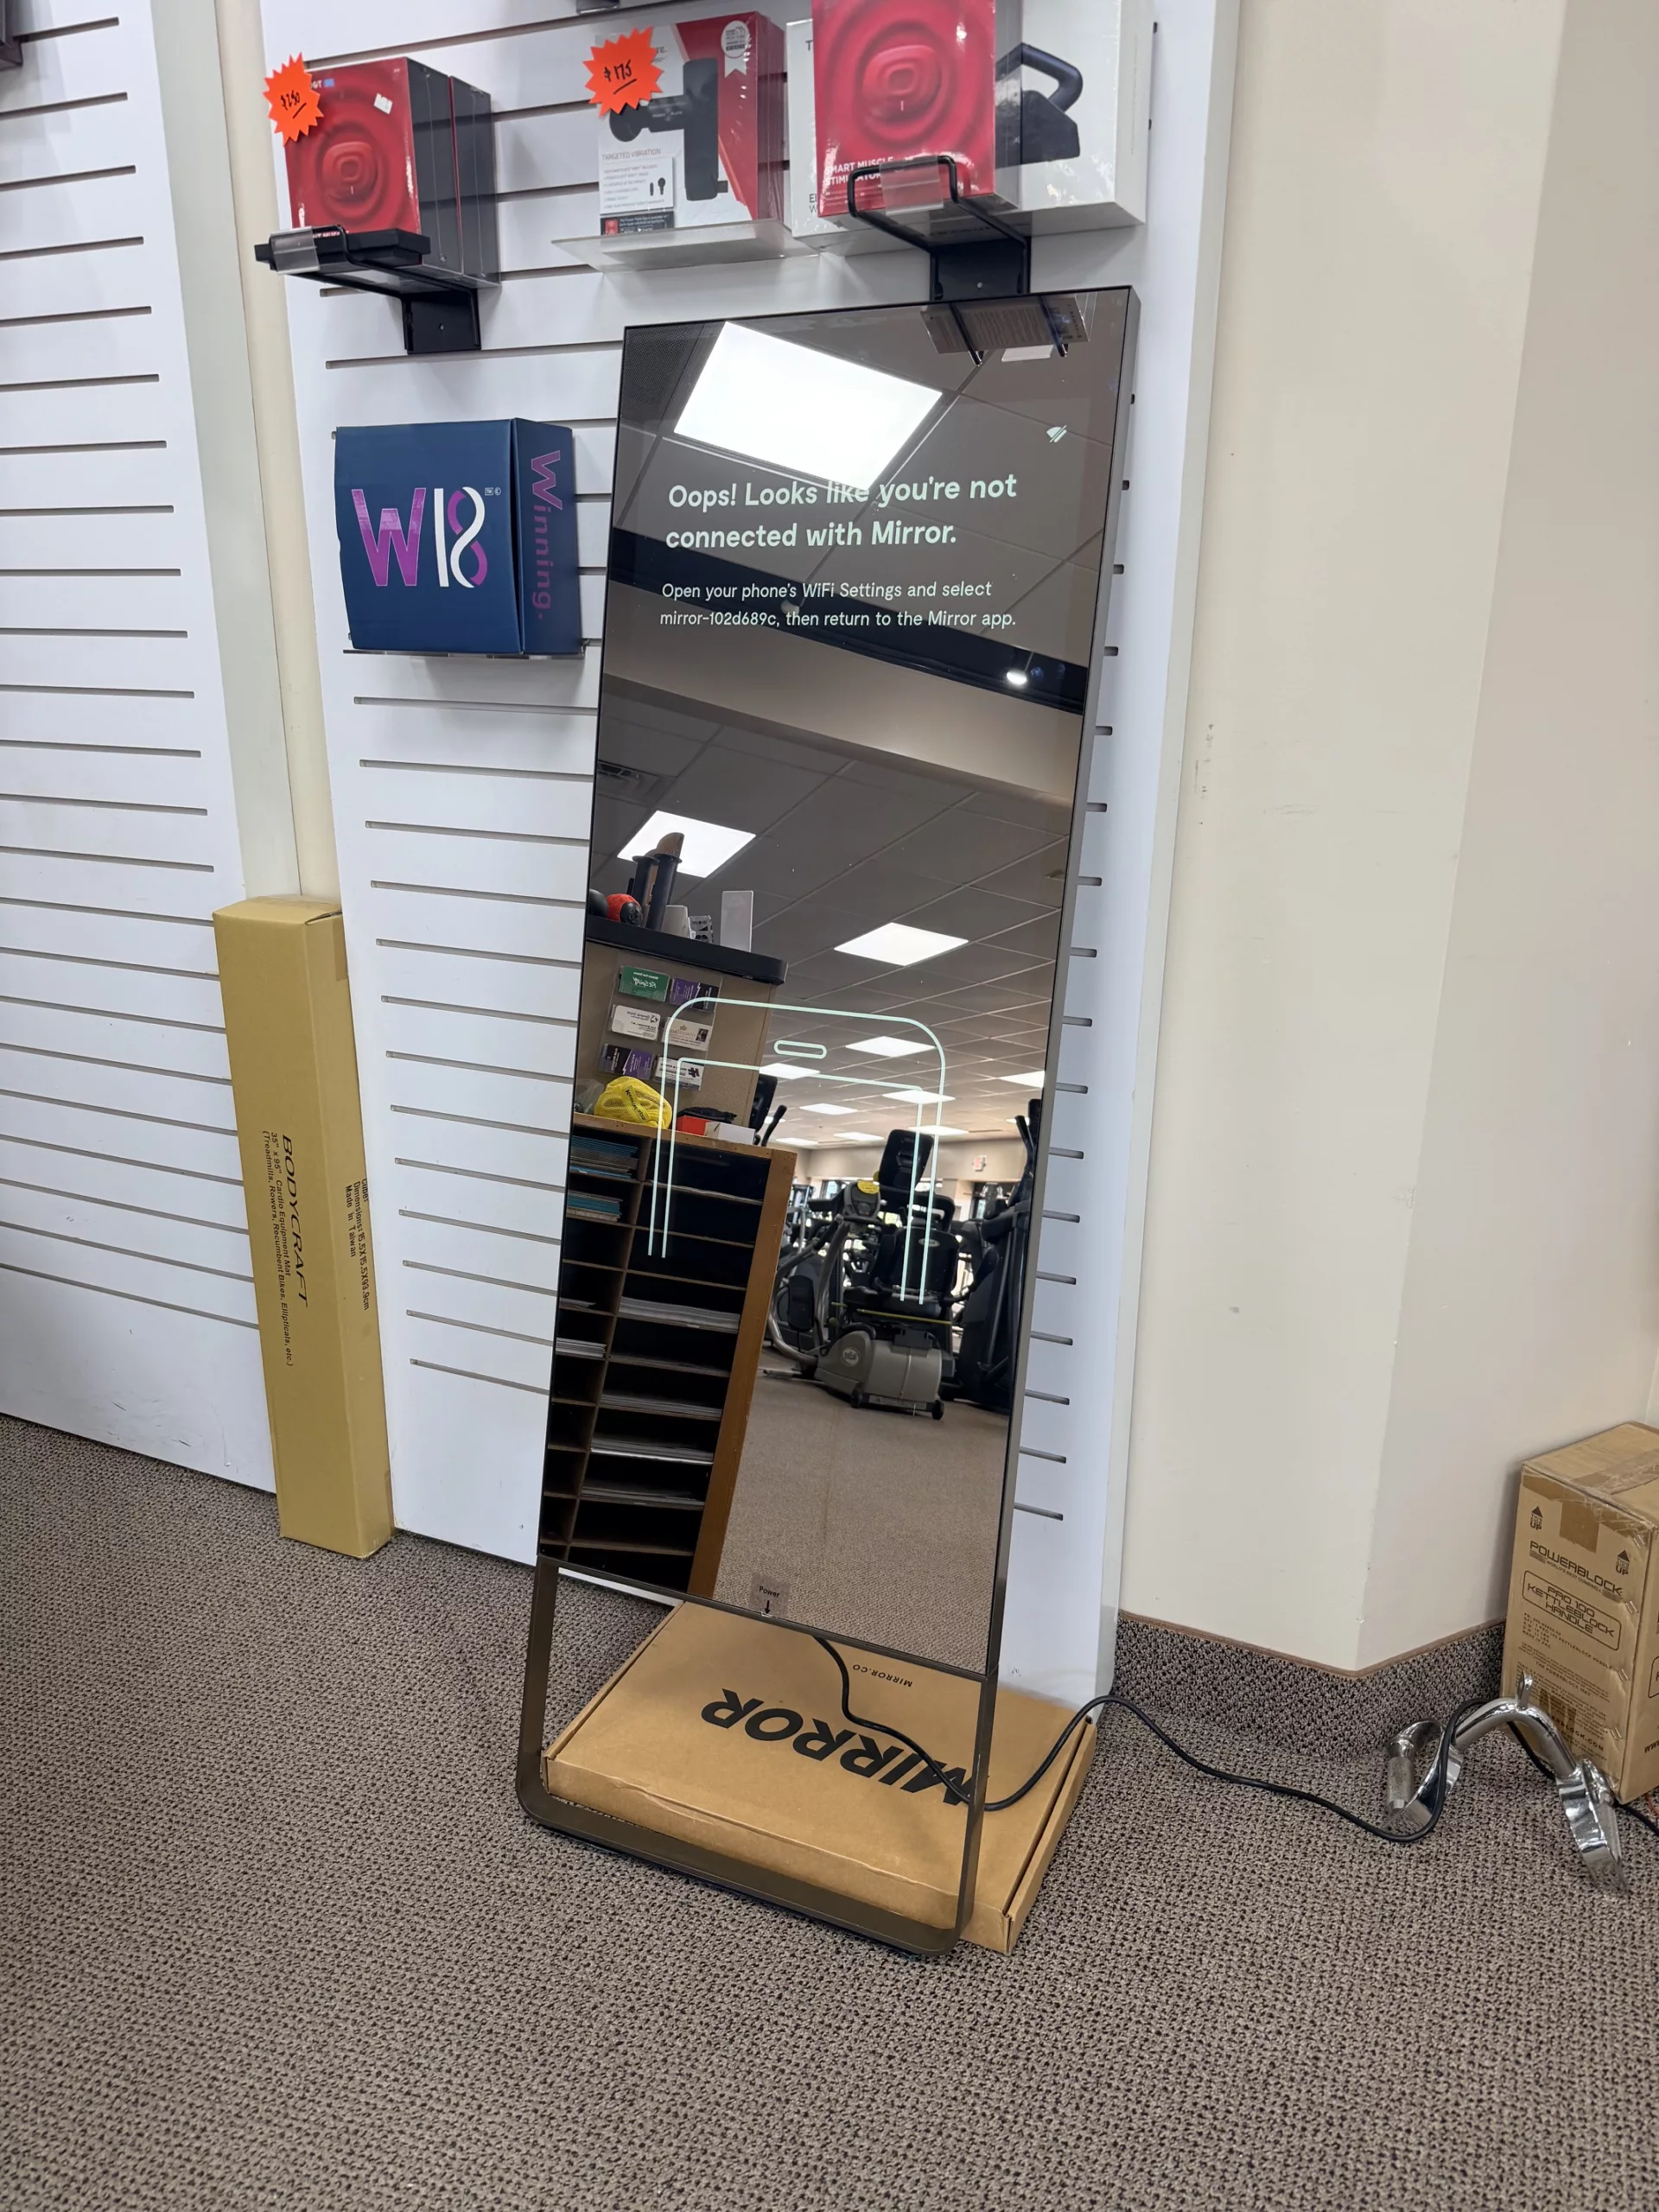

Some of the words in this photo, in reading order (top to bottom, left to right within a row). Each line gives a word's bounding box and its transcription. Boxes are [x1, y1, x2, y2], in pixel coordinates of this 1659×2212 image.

[603, 59, 632, 82] $175
[601, 151, 631, 161] TARGETED
[632, 149, 661, 157] VIBRATION
[668, 483, 737, 512] Oops!
[745, 481, 817, 506] Looks
[826, 480, 870, 504] like
[877, 476, 961, 508] you're
[969, 474, 1017, 499] not
[665, 523, 798, 549] connected
[806, 522, 862, 547] with
[871, 520, 957, 546] Mirror.
[662, 582, 701, 602] Open
[705, 584, 738, 602] your
[741, 582, 797, 601] phone's
[802, 582, 835, 597] WiFi
[839, 582, 902, 601] Settings
[907, 582, 937, 597] and
[942, 581, 993, 596] select
[659, 610, 780, 628] mirror-102d689c,
[785, 610, 819, 626] then
[823, 612, 870, 627] return
[874, 612, 892, 626] to
[897, 610, 923, 626] the
[928, 610, 977, 626] Mirror
[982, 613, 1016, 630] app.
[262, 1130, 275, 1184] (Treadmills,
[269, 1185, 280, 1222] Rowers,
[276, 1179, 285, 1210] Cardio
[345, 1185, 354, 1208] Made
[278, 1211, 291, 1258] Equipment
[282, 1134, 308, 1308] BODYCRAFT
[272, 1224, 285, 1273] Recumbent
[347, 1225, 358, 1257] Taiwan
[277, 1274, 289, 1301] Bikes,
[281, 1302, 292, 1346] Ellipticals,
[285, 1348, 294, 1367] etc.)
[1529, 1521, 1542, 1531] UP
[1529, 1541, 1623, 1597] POWERBLOCK
[1616, 1565, 1629, 1576] UP
[759, 1585, 781, 1599] Power
[1548, 1586, 1572, 1603] PRO
[1574, 1600, 1595, 1618] 100
[1528, 1583, 1615, 1638] KETTLEBLOCK
[1545, 1601, 1593, 1634] HANDLE
[852, 1663, 913, 1688] MIRROR.CO
[700, 1688, 989, 1807] MIRROR
